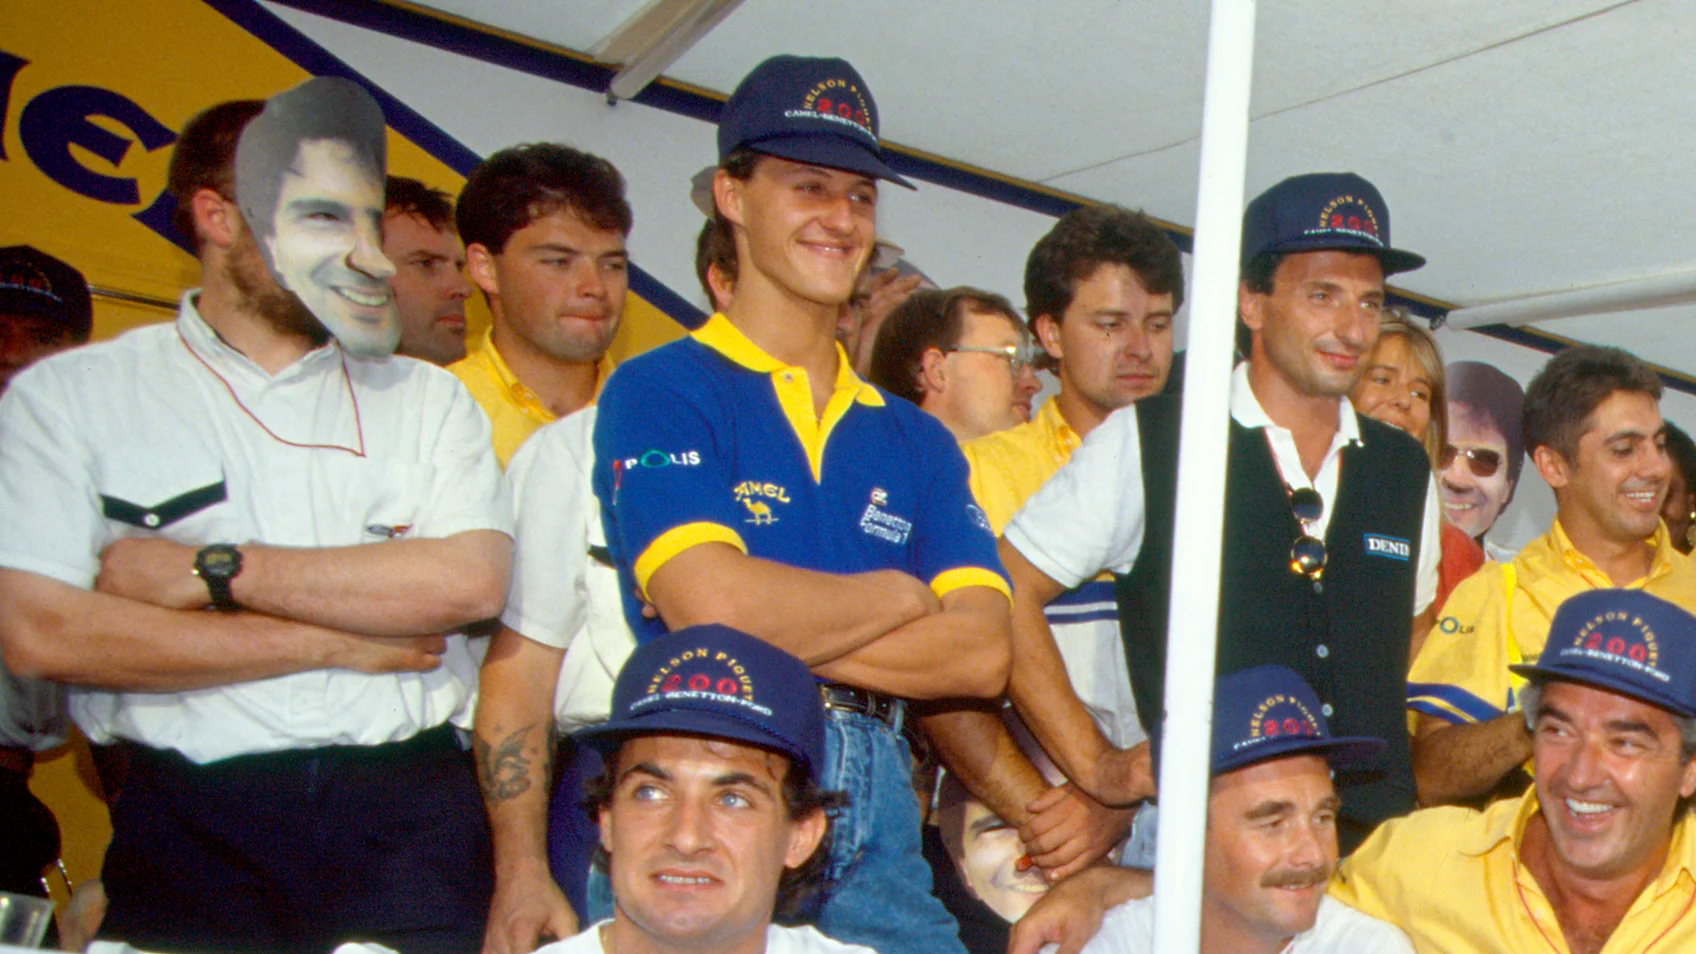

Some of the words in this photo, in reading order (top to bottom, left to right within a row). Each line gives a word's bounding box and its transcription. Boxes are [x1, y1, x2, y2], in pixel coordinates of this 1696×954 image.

[804, 79, 846, 110] NELSON
[817, 98, 866, 127] 200
[1330, 213, 1374, 235] 200
[1573, 612, 1629, 646] NELSON
[1585, 632, 1647, 662] 200
[646, 648, 708, 694] NELSON
[715, 651, 753, 701] PIQUET
[661, 673, 738, 695] 200
